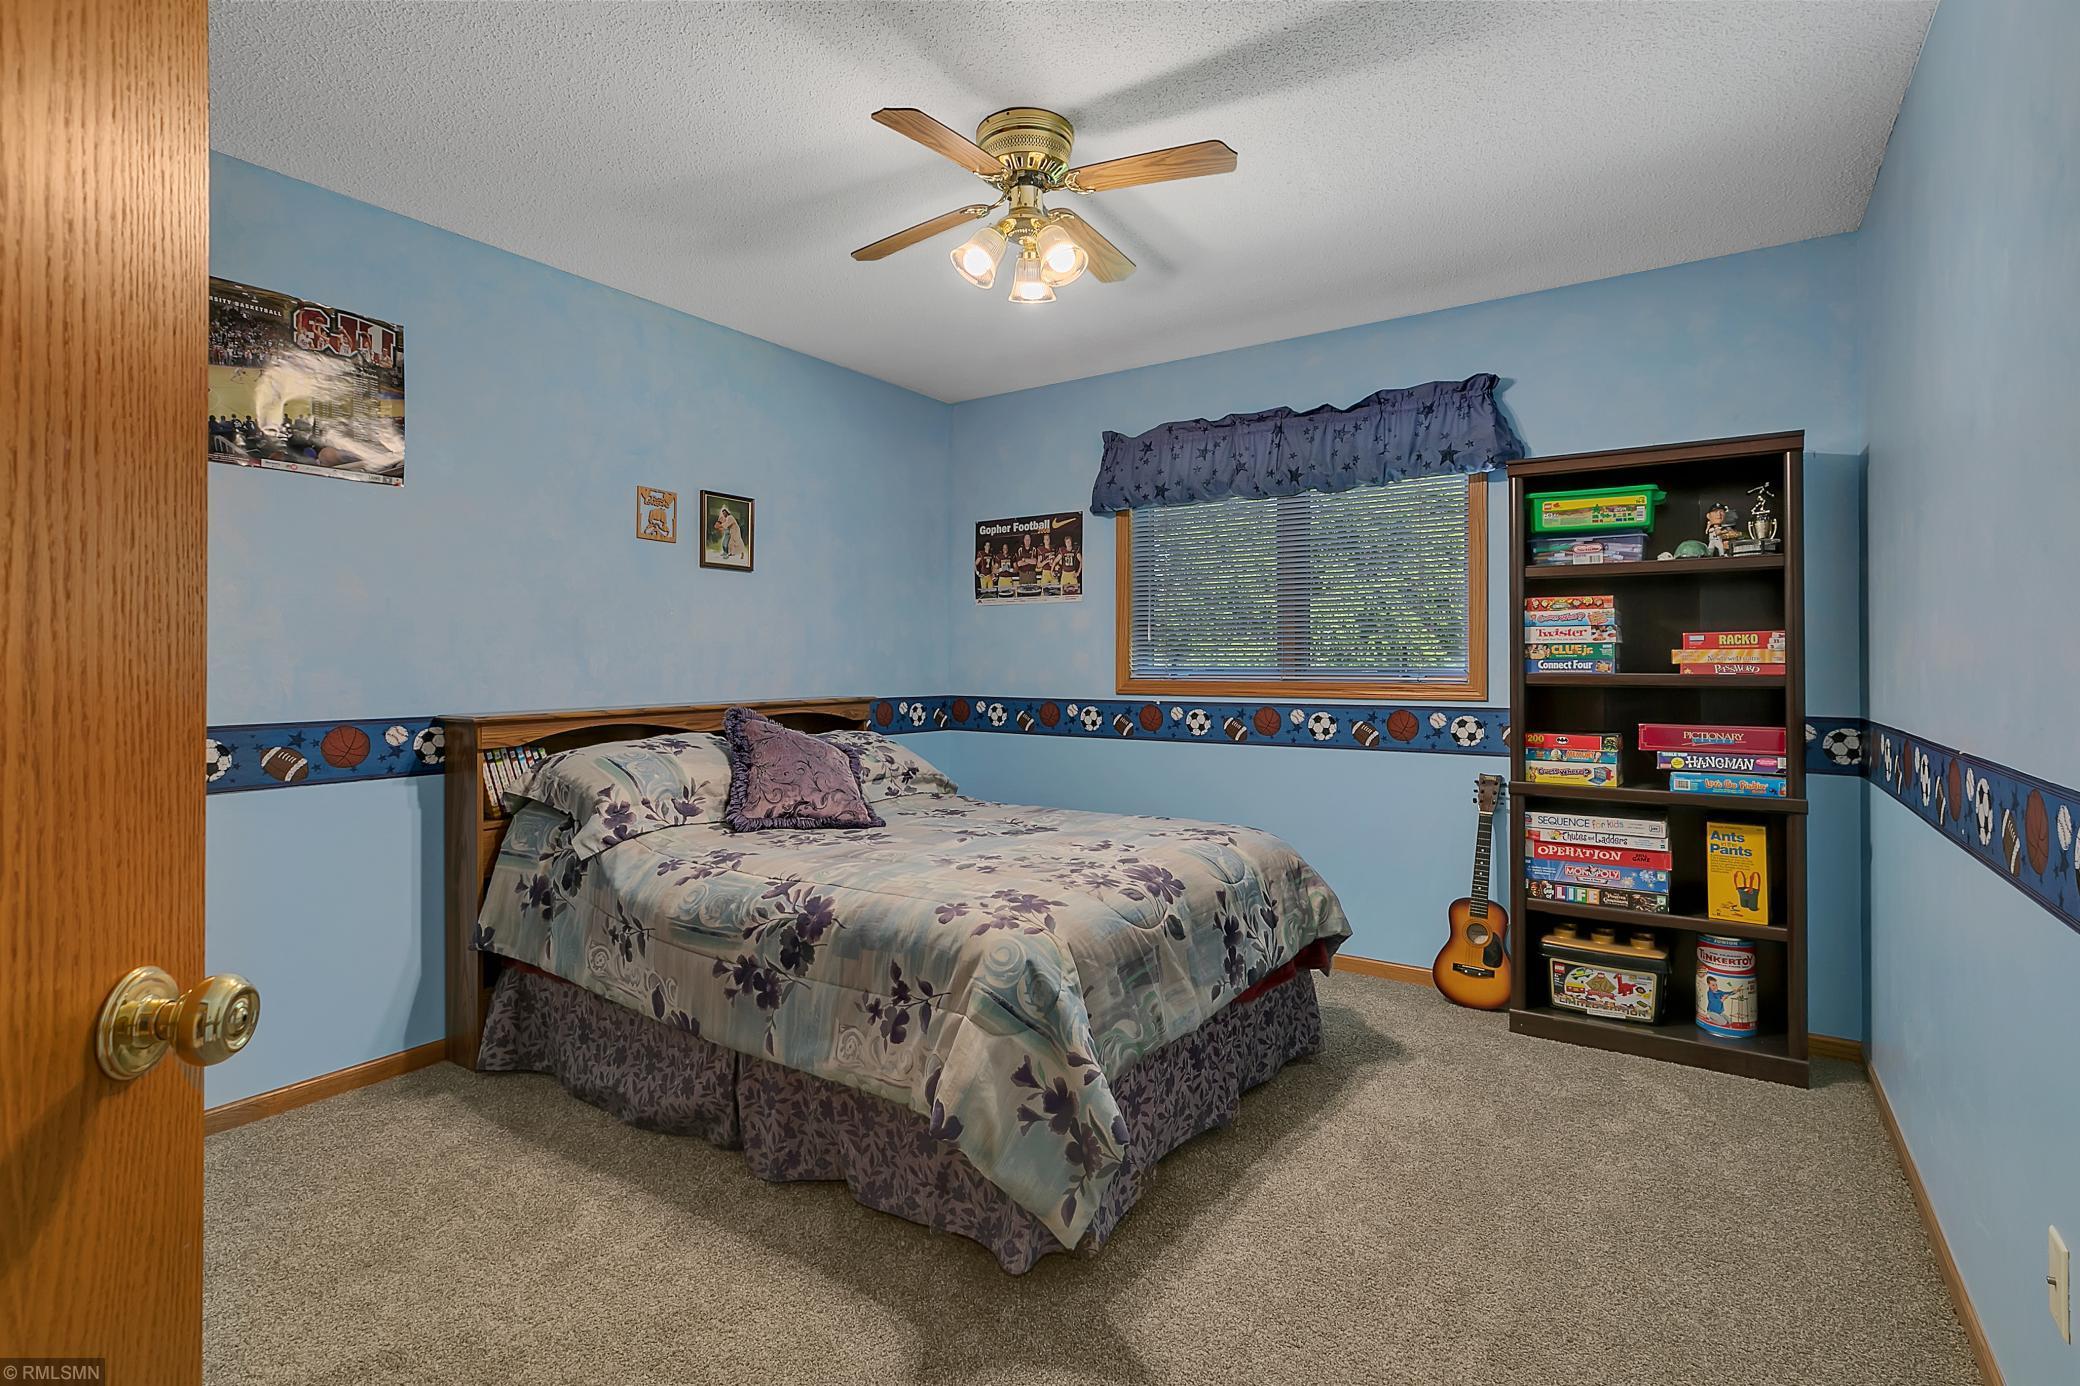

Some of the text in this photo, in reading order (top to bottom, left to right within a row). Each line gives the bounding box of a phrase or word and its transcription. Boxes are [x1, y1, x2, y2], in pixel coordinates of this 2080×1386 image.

[980, 519, 1050, 536] Gopher Football
[1536, 628, 1587, 637] Twister
[1551, 644, 1581, 654] CLUE
[1538, 660, 1593, 669] Connect Four
[1527, 734, 1544, 743] 200
[1683, 731, 1744, 741] PICTIONARY
[1685, 755, 1754, 771] HANGMAN
[1537, 815, 1590, 828] SEQUENCE
[1591, 819, 1606, 829] for
[1562, 831, 1587, 841] Chutes
[1595, 832, 1628, 846] Ladders
[1710, 830, 1745, 843] Ants
[1537, 845, 1622, 861] OPERATION
[1709, 843, 1752, 857] Pants
[1565, 865, 1619, 879] MONOPOLY
[1556, 885, 1598, 904] LIFE
